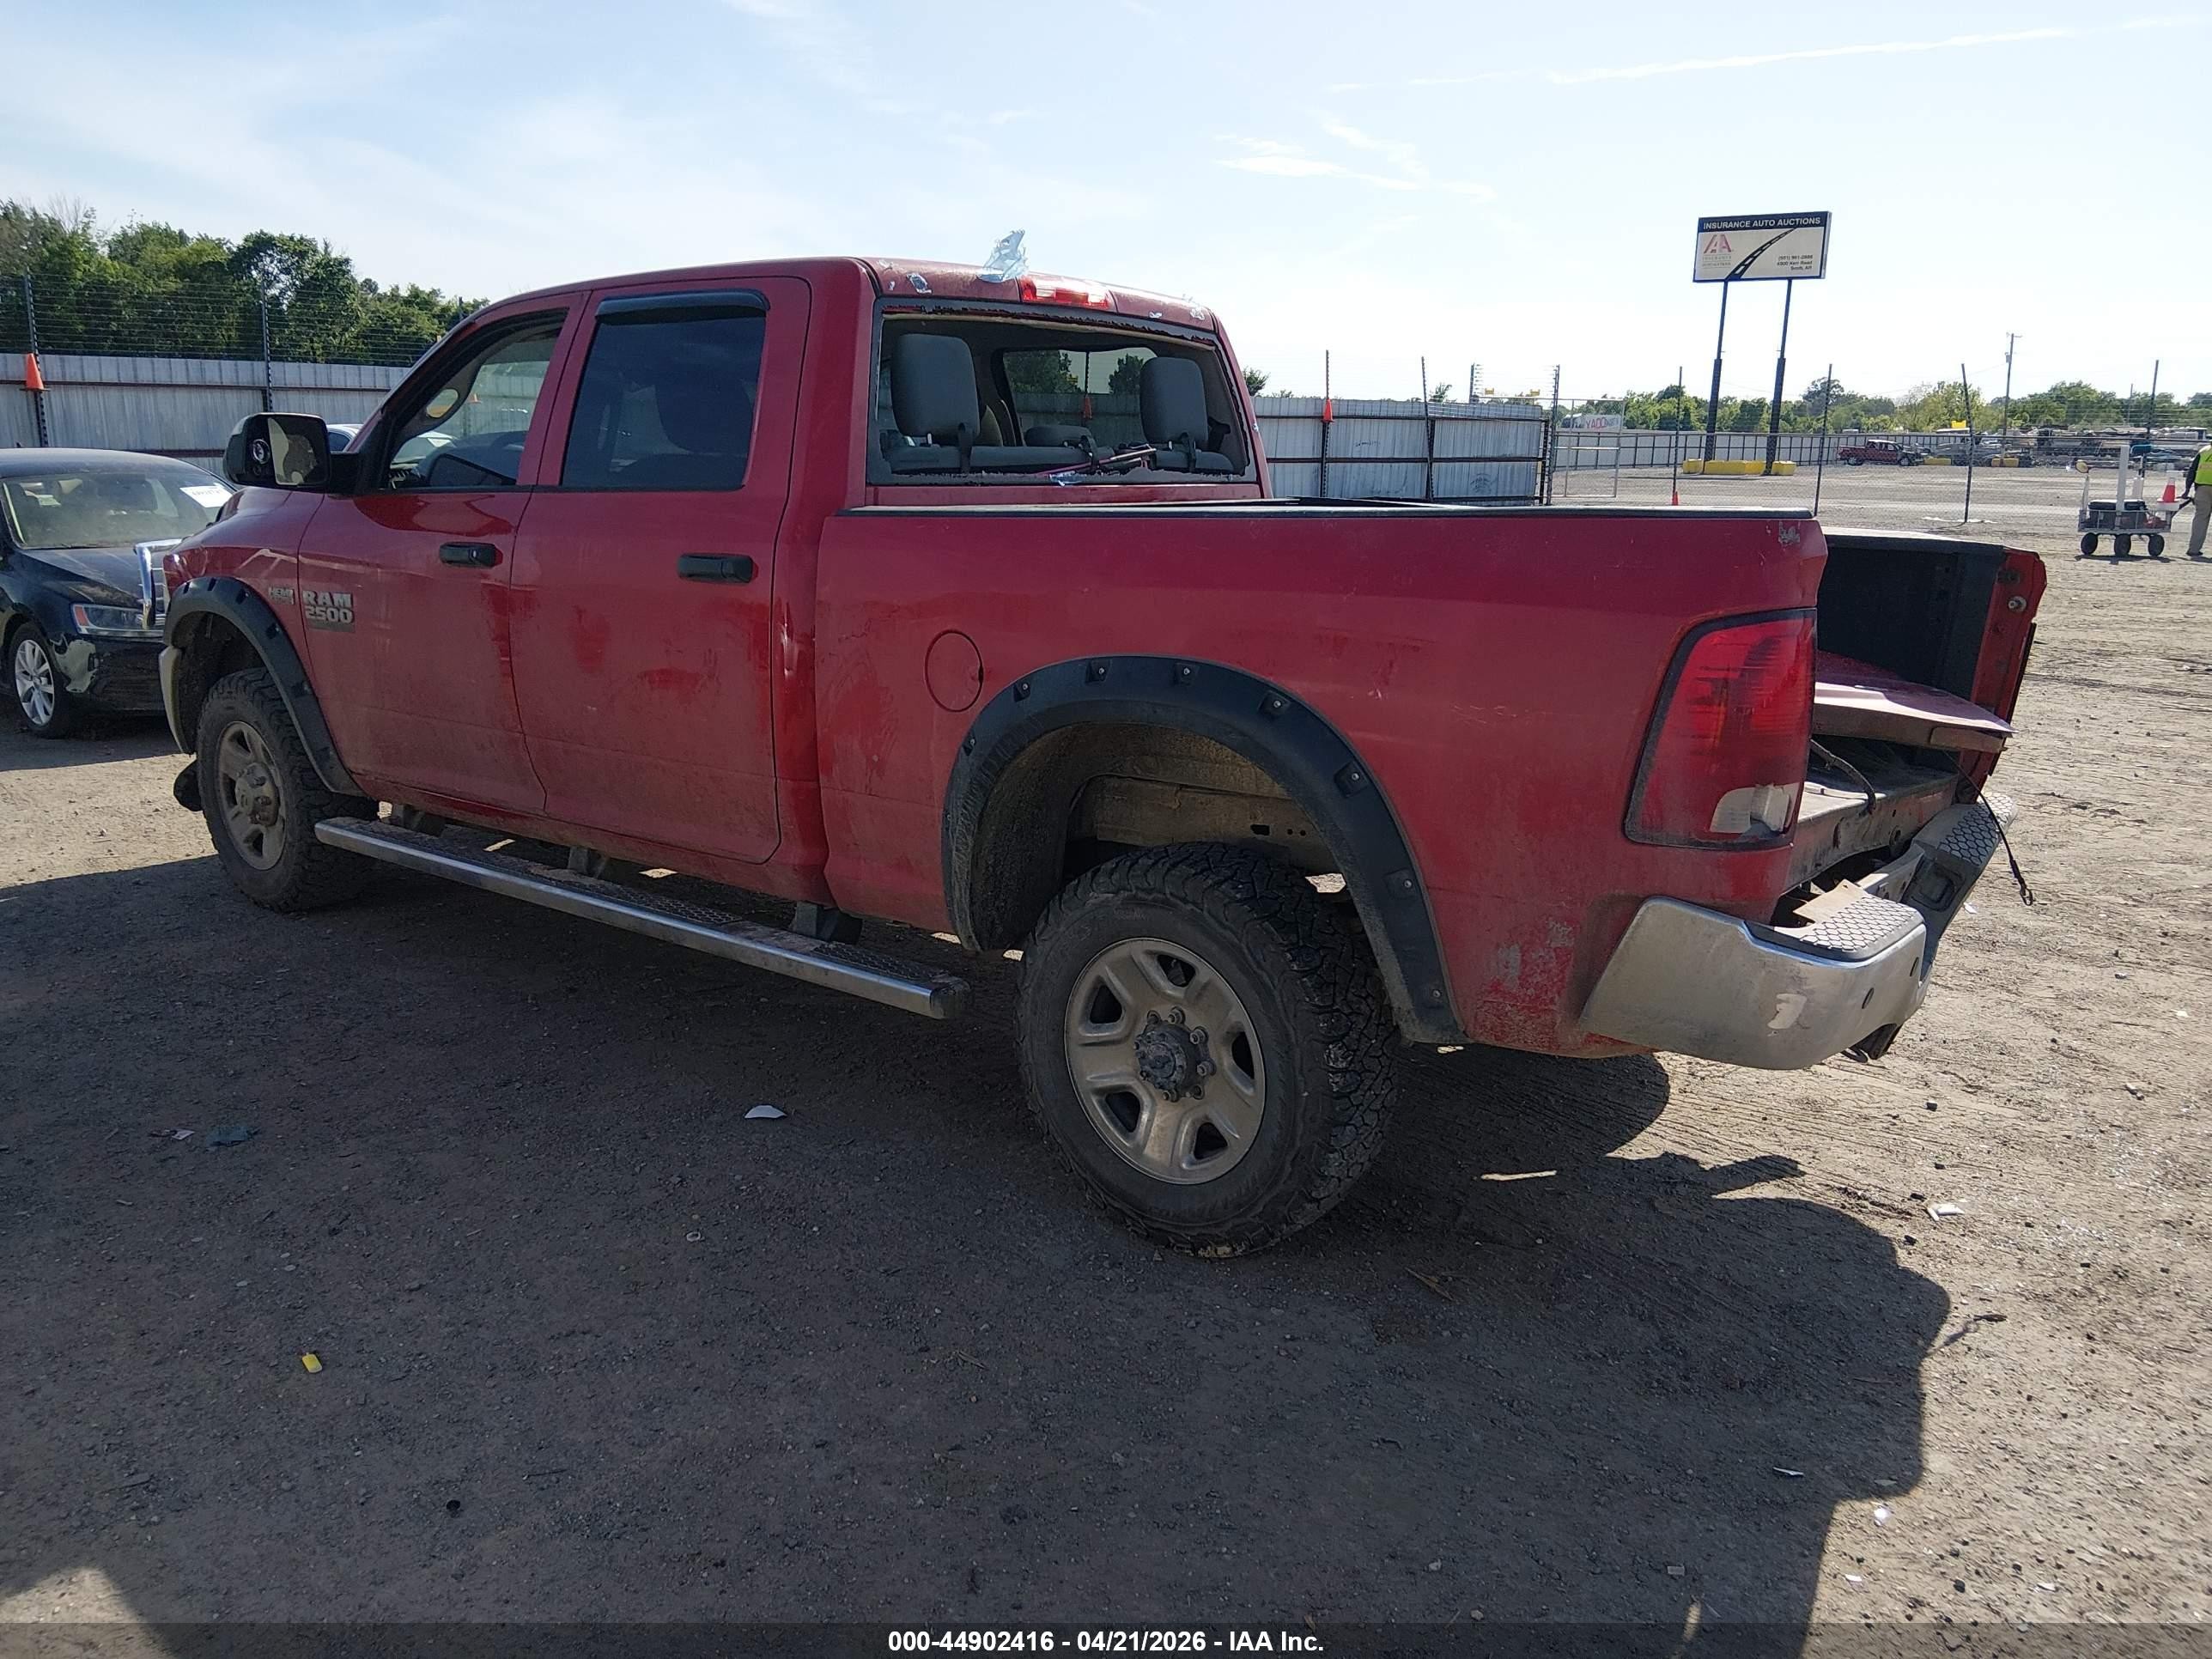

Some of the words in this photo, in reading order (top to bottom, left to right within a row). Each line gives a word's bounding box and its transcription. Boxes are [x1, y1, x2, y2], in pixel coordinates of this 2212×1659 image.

[1704, 220, 1750, 229] INSURANCE
[1778, 217, 1820, 227] AUCTIONS
[302, 590, 353, 609] RAM
[304, 605, 354, 624] 2500
